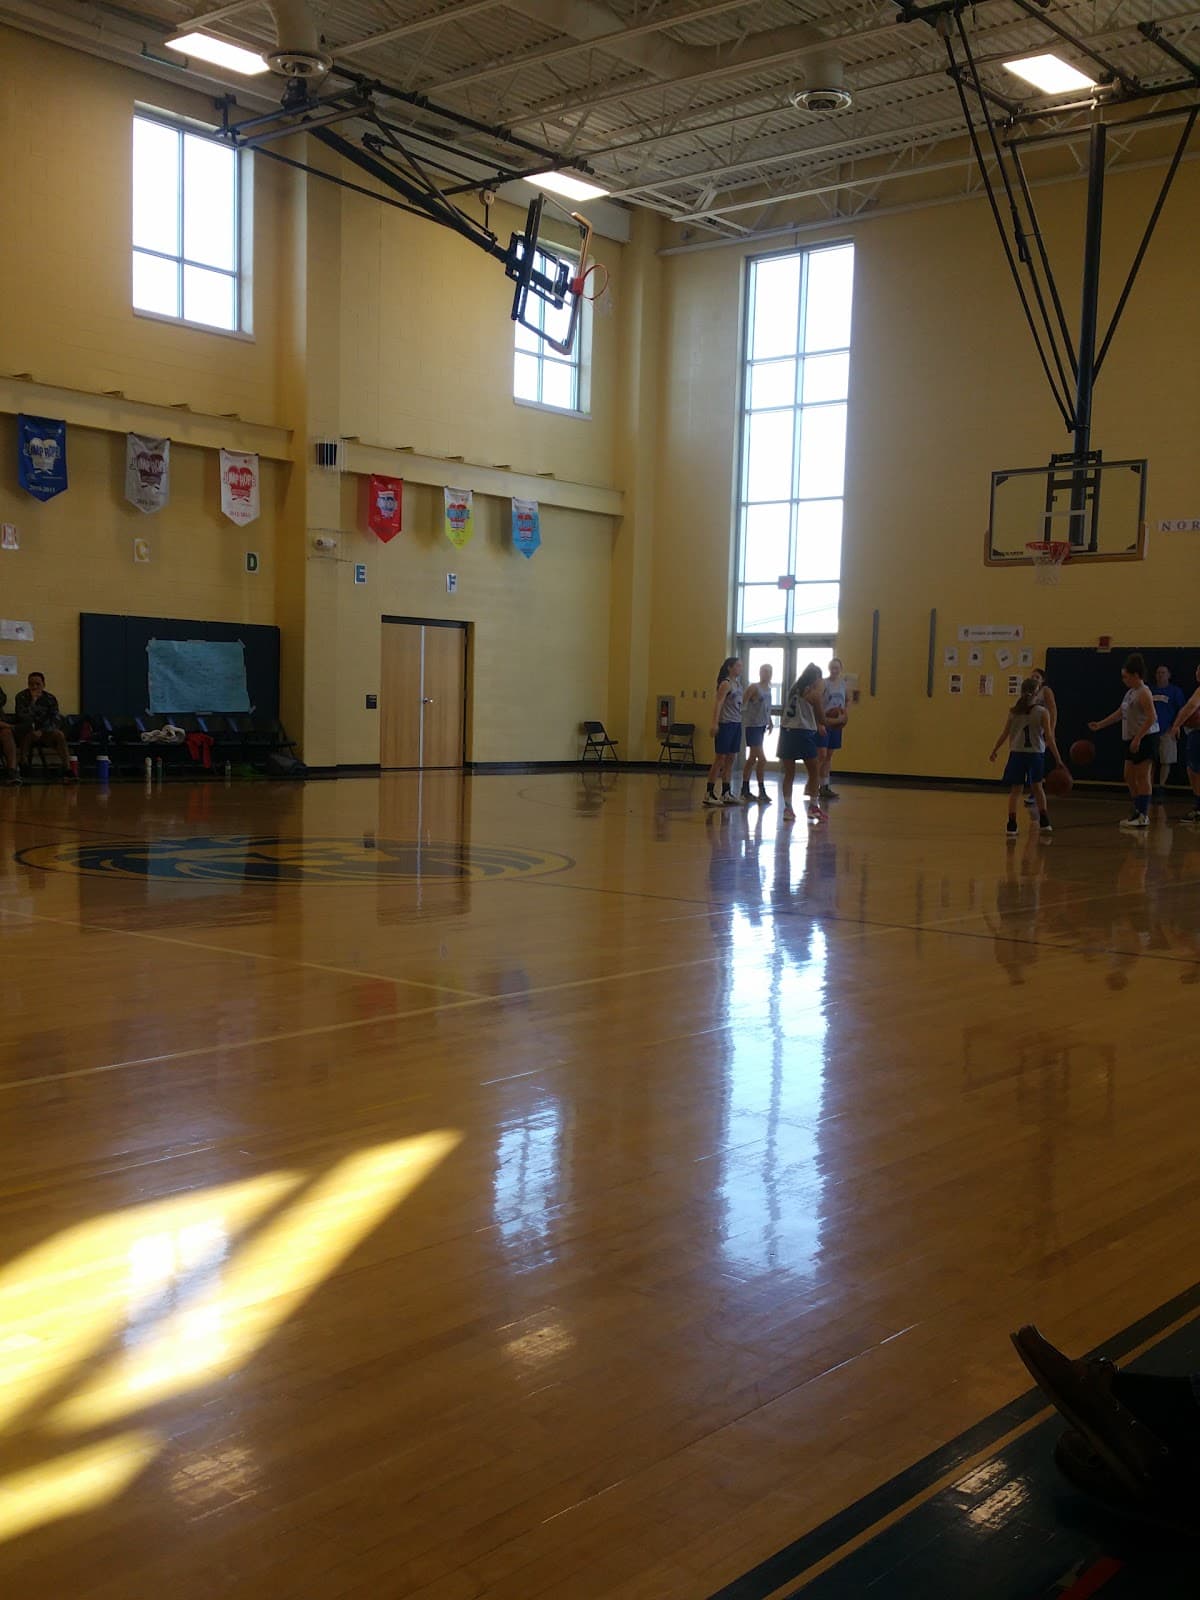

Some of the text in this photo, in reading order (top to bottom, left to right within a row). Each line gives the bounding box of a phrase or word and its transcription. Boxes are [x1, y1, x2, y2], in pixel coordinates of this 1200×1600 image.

[23, 440, 43, 457] JUMP
[223, 471, 257, 488] JUMP ROPE
[247, 552, 258, 571] D
[356, 565, 365, 582] E
[448, 574, 457, 591] F
[1023, 725, 1033, 748] 1
